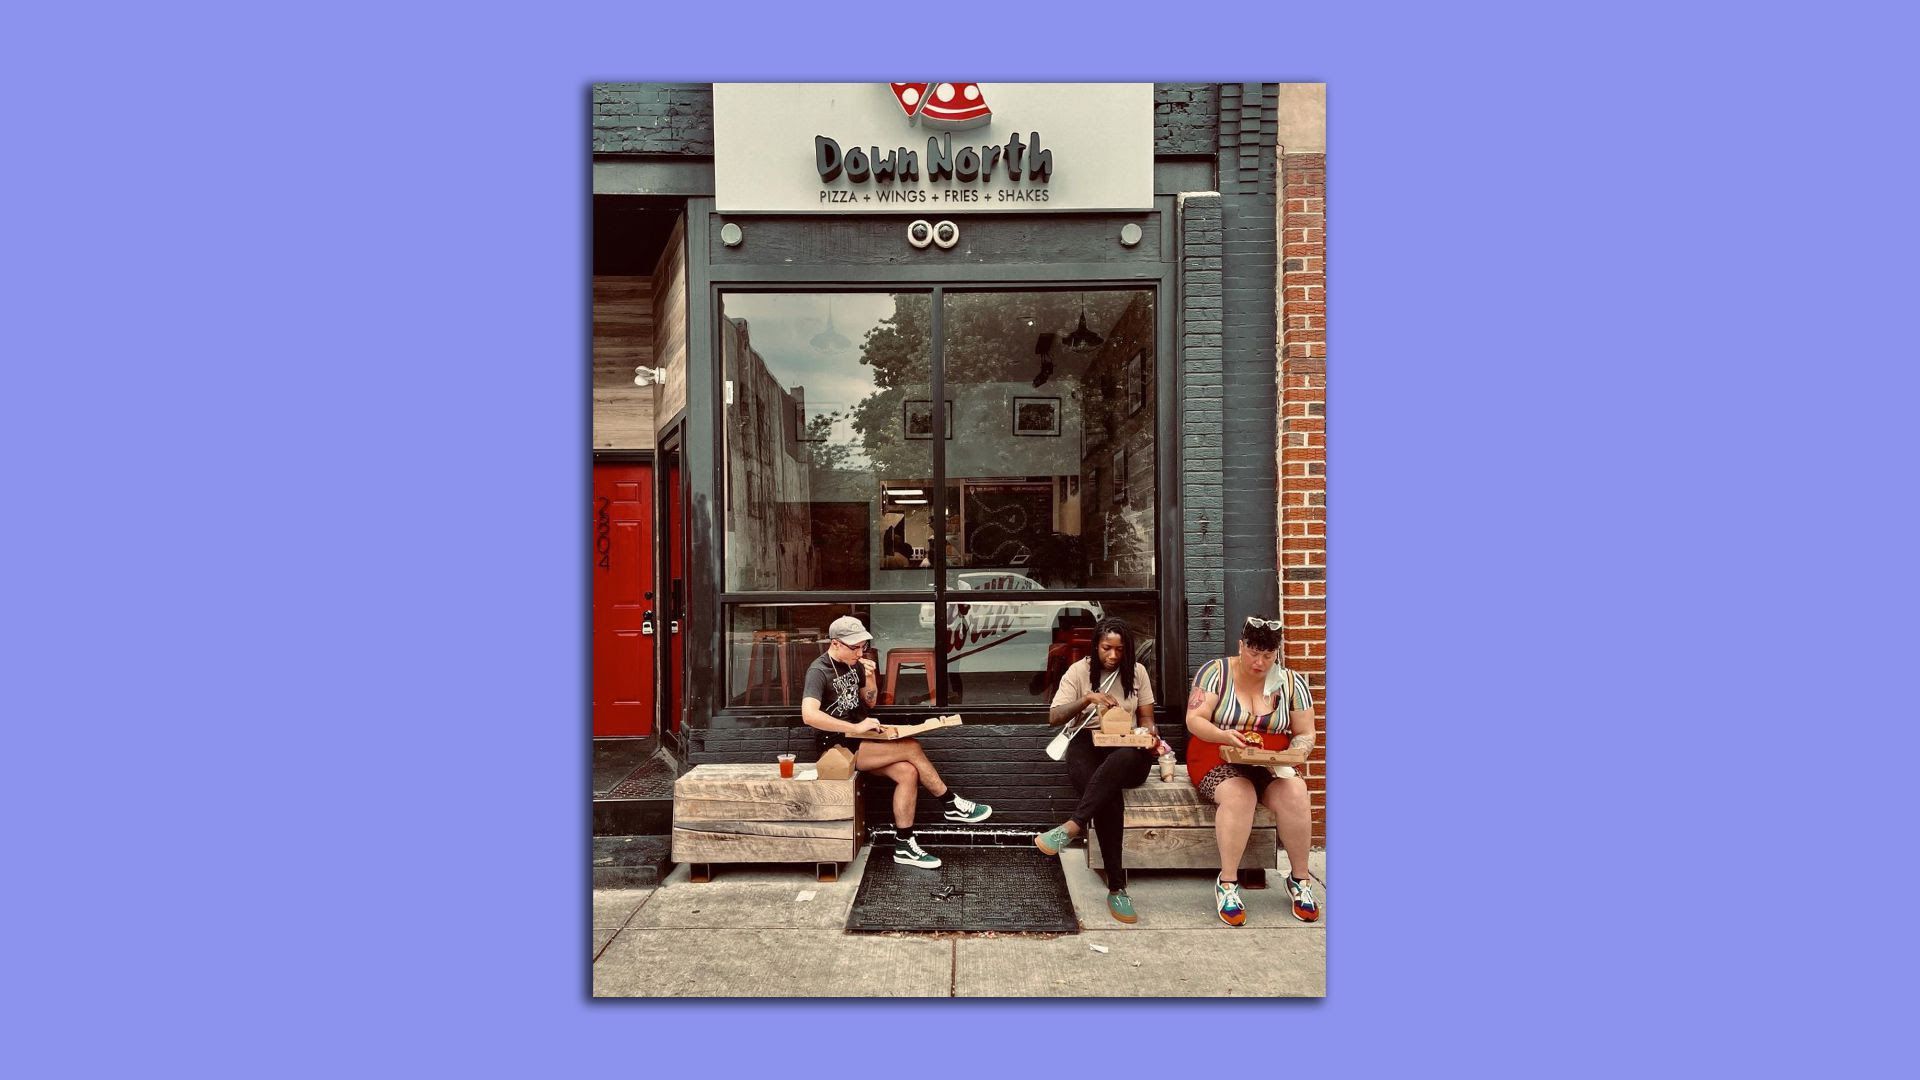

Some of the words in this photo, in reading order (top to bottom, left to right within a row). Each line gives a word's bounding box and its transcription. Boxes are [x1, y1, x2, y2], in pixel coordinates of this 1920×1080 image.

[815, 135, 919, 183] Down
[927, 132, 1053, 183] North
[819, 190, 858, 203] PIZZA
[876, 190, 926, 203] WINGS
[944, 189, 979, 202] FRIES
[998, 188, 1050, 202] SHAKES
